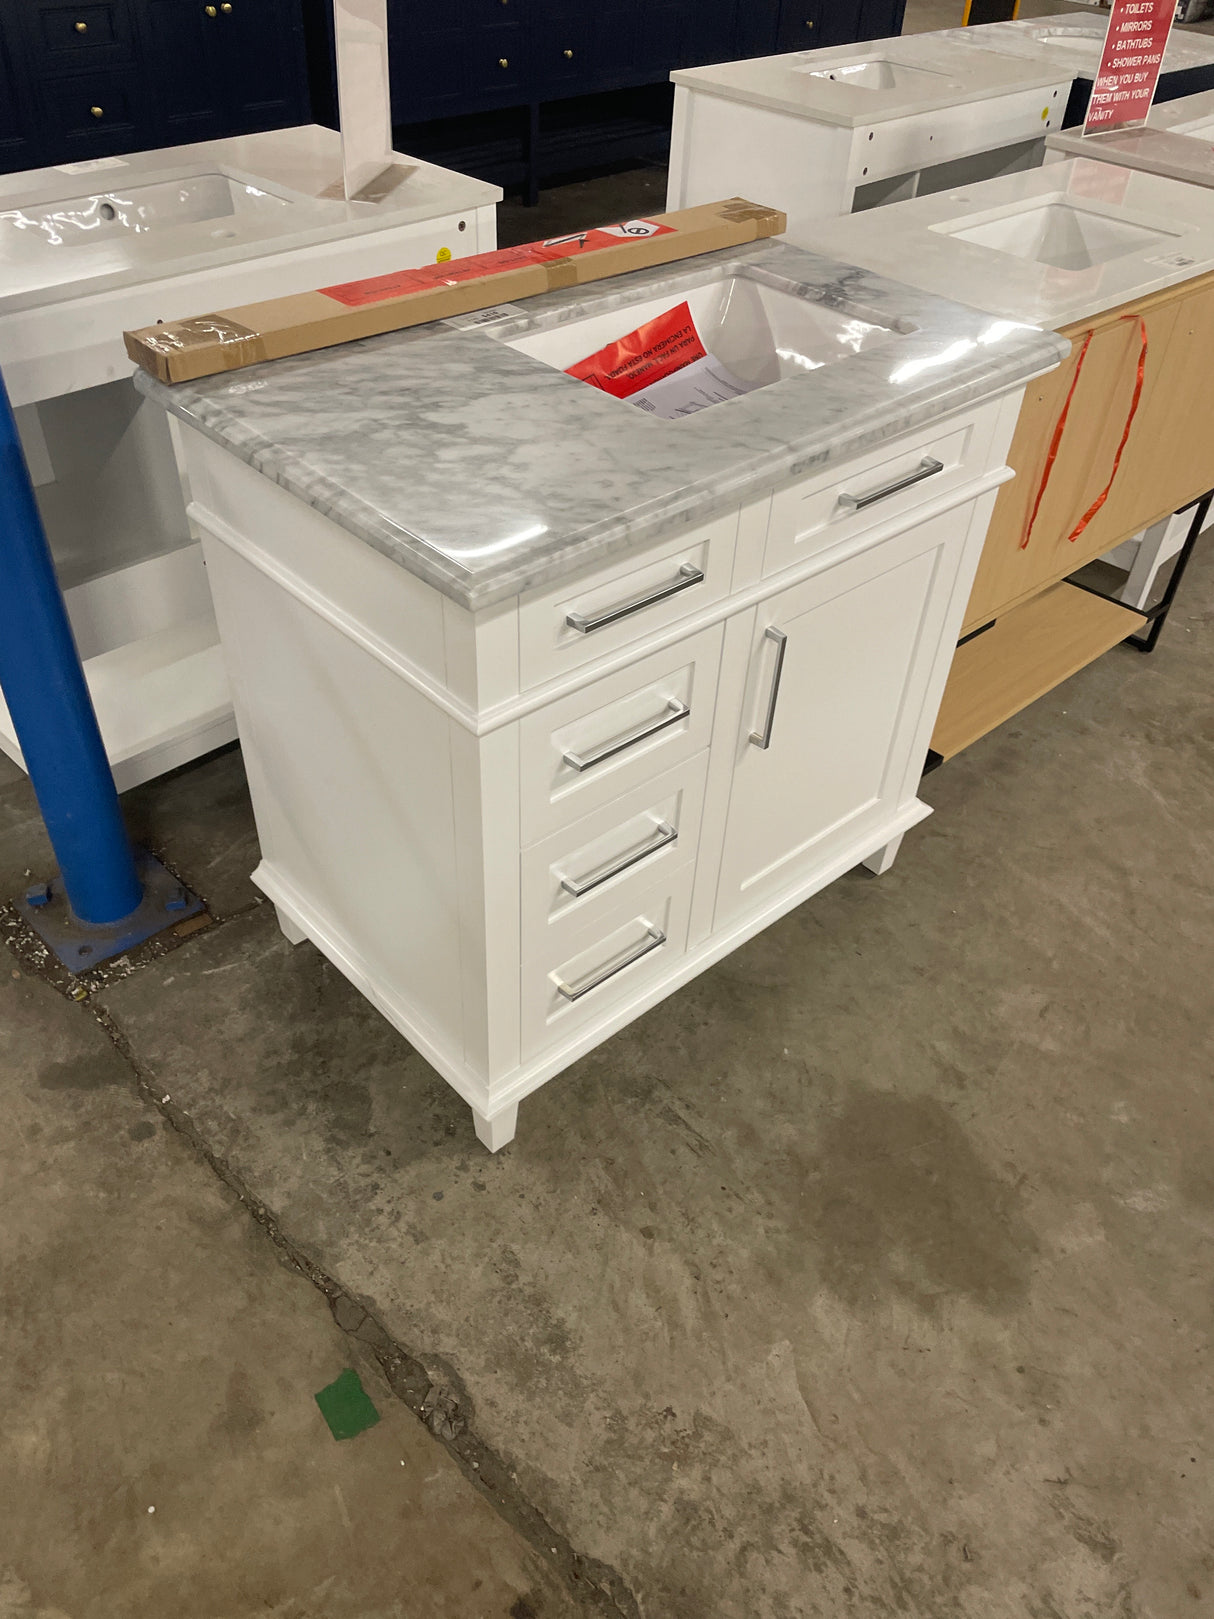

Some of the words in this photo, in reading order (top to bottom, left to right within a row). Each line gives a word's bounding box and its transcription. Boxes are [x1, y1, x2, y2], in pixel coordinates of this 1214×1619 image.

[1125, 2, 1154, 14] TOILETS
[1120, 20, 1153, 32] MIRRORS
[1116, 38, 1153, 51] BATHTUBS
[1111, 56, 1142, 69] SHOWER
[1142, 53, 1161, 65] PANS
[1097, 75, 1118, 87] WHEN
[1119, 73, 1135, 85] YOU
[1134, 71, 1149, 83] BUY
[1092, 93, 1113, 105] THEM
[1112, 91, 1131, 103] WITH
[1130, 88, 1150, 99] YOUR
[1088, 109, 1114, 122] VANITY
[683, 325, 692, 334] LA
[653, 330, 683, 352] ENCIMERA
[680, 335, 695, 348] PARA
[643, 350, 653, 358] NO
[670, 345, 680, 353] UN
[653, 351, 670, 364] FACL
